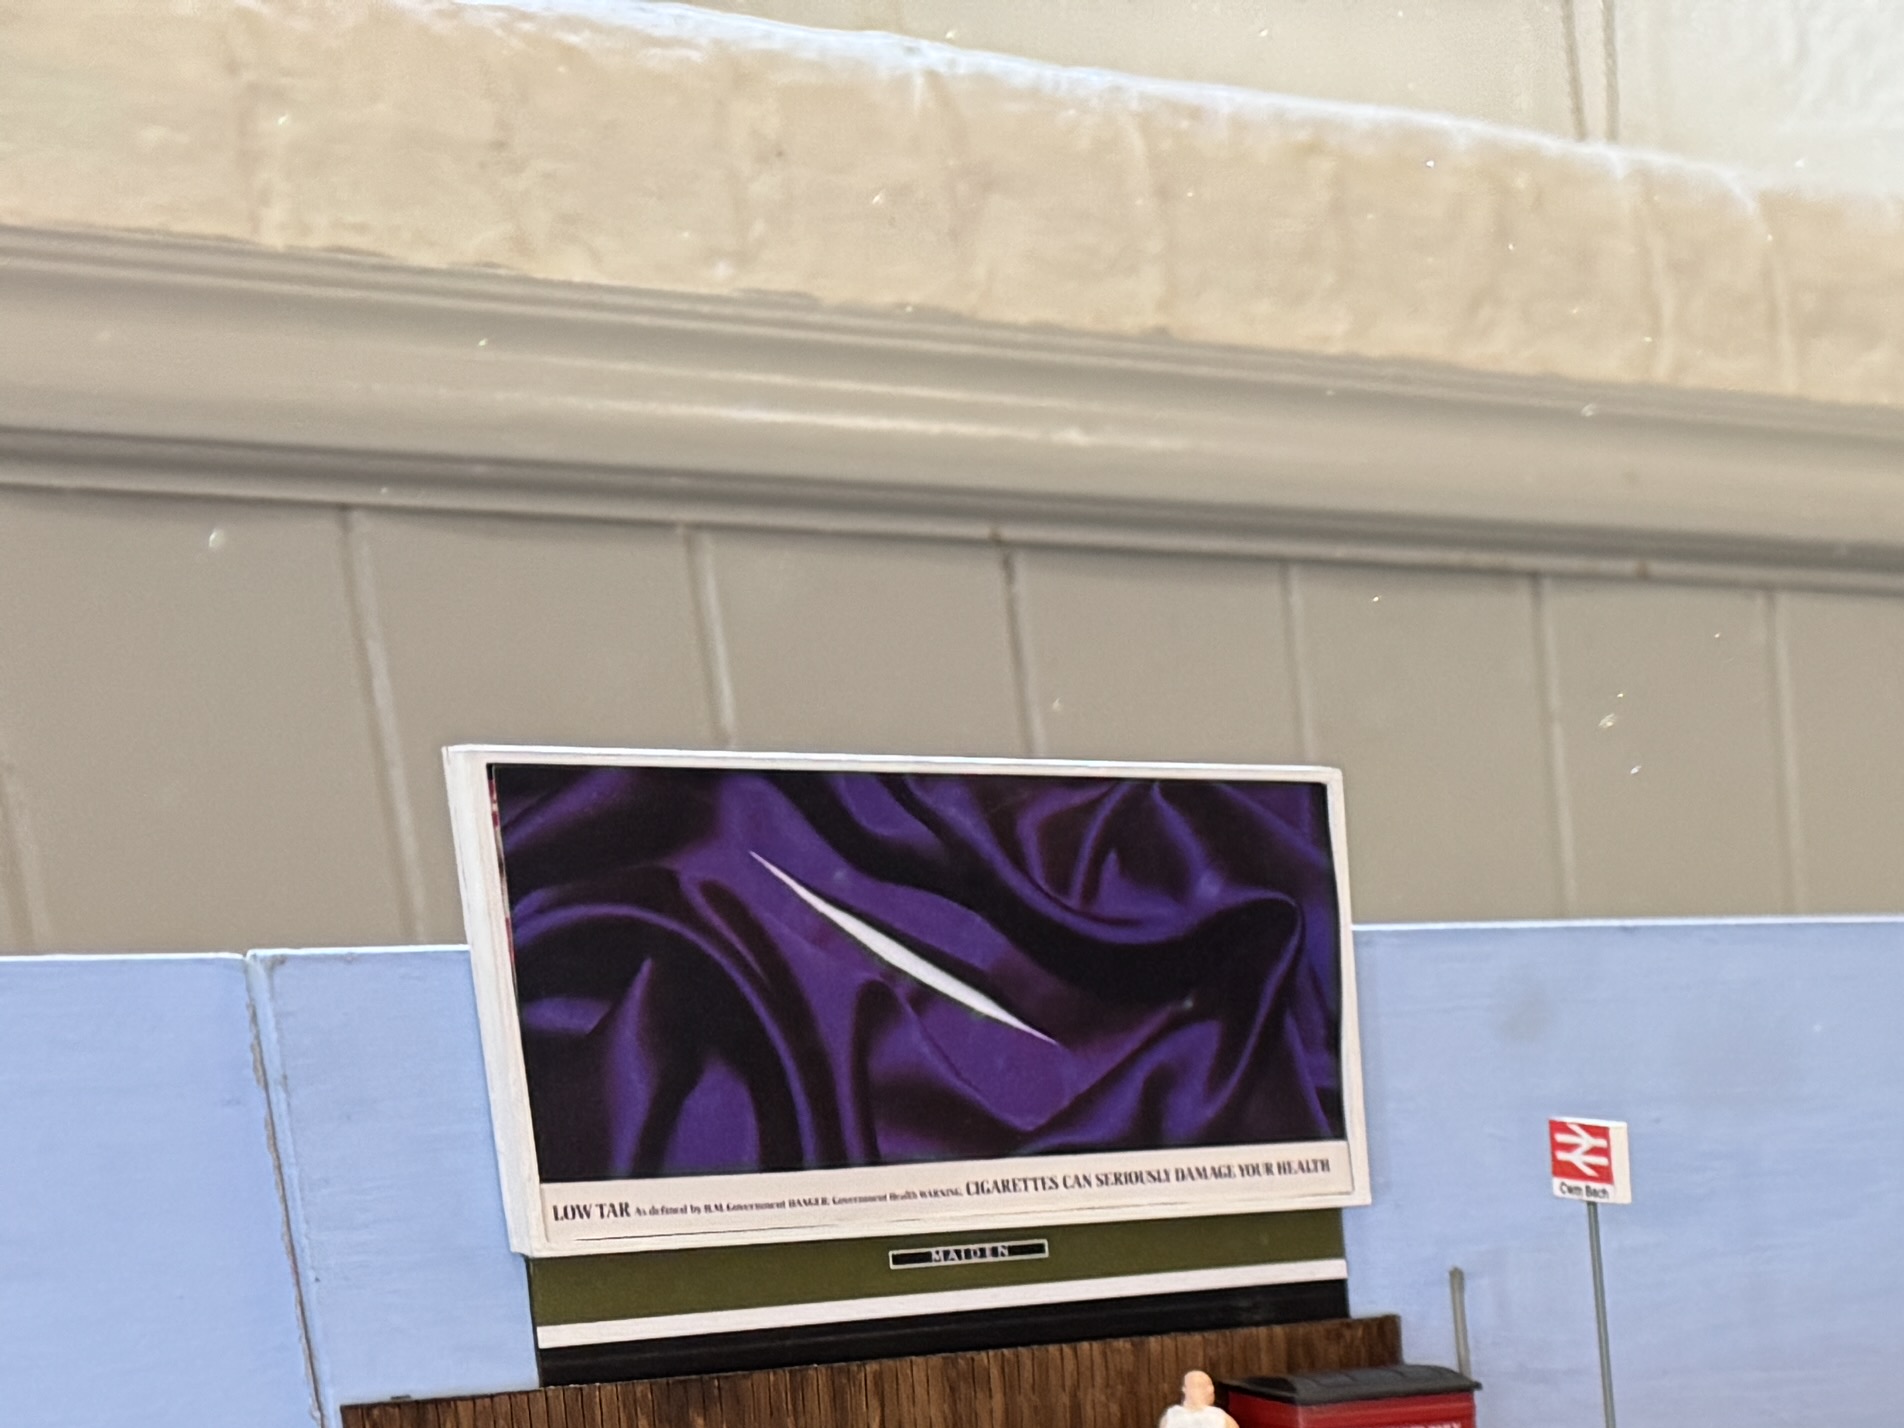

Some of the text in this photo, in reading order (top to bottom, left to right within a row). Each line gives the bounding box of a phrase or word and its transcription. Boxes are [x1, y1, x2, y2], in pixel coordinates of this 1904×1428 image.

[553, 1204, 591, 1221] LOW
[596, 1202, 631, 1219] TAR
[690, 1203, 702, 1216] by
[965, 1175, 1060, 1197] CIGARETTES
[1062, 1174, 1093, 1191] CAN
[1095, 1168, 1172, 1188] SERIOUSLY
[1175, 1164, 1237, 1183] DAMAGE
[1238, 1161, 1275, 1179] YOUR
[1277, 1158, 1331, 1175] HEALTH
[1559, 1181, 1611, 1201] Cwm Bach
[931, 1245, 1010, 1263] MAIDEN
